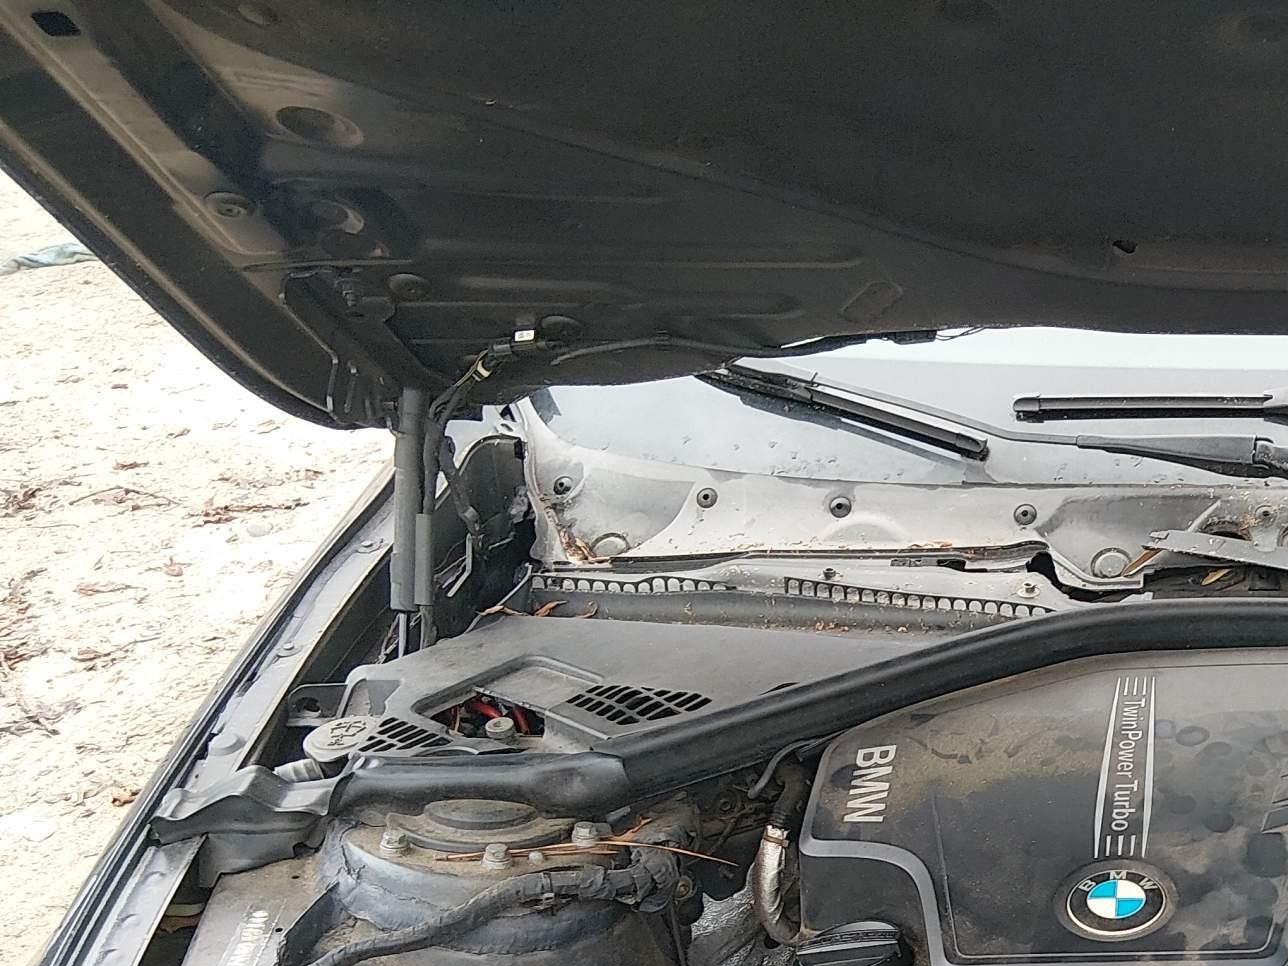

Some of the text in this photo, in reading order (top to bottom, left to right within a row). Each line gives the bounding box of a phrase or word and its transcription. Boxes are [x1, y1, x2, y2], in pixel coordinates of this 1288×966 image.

[843, 744, 897, 822] BMW
[1111, 697, 1146, 832] TwinPower Turbo
[1078, 869, 1158, 892] BMW
